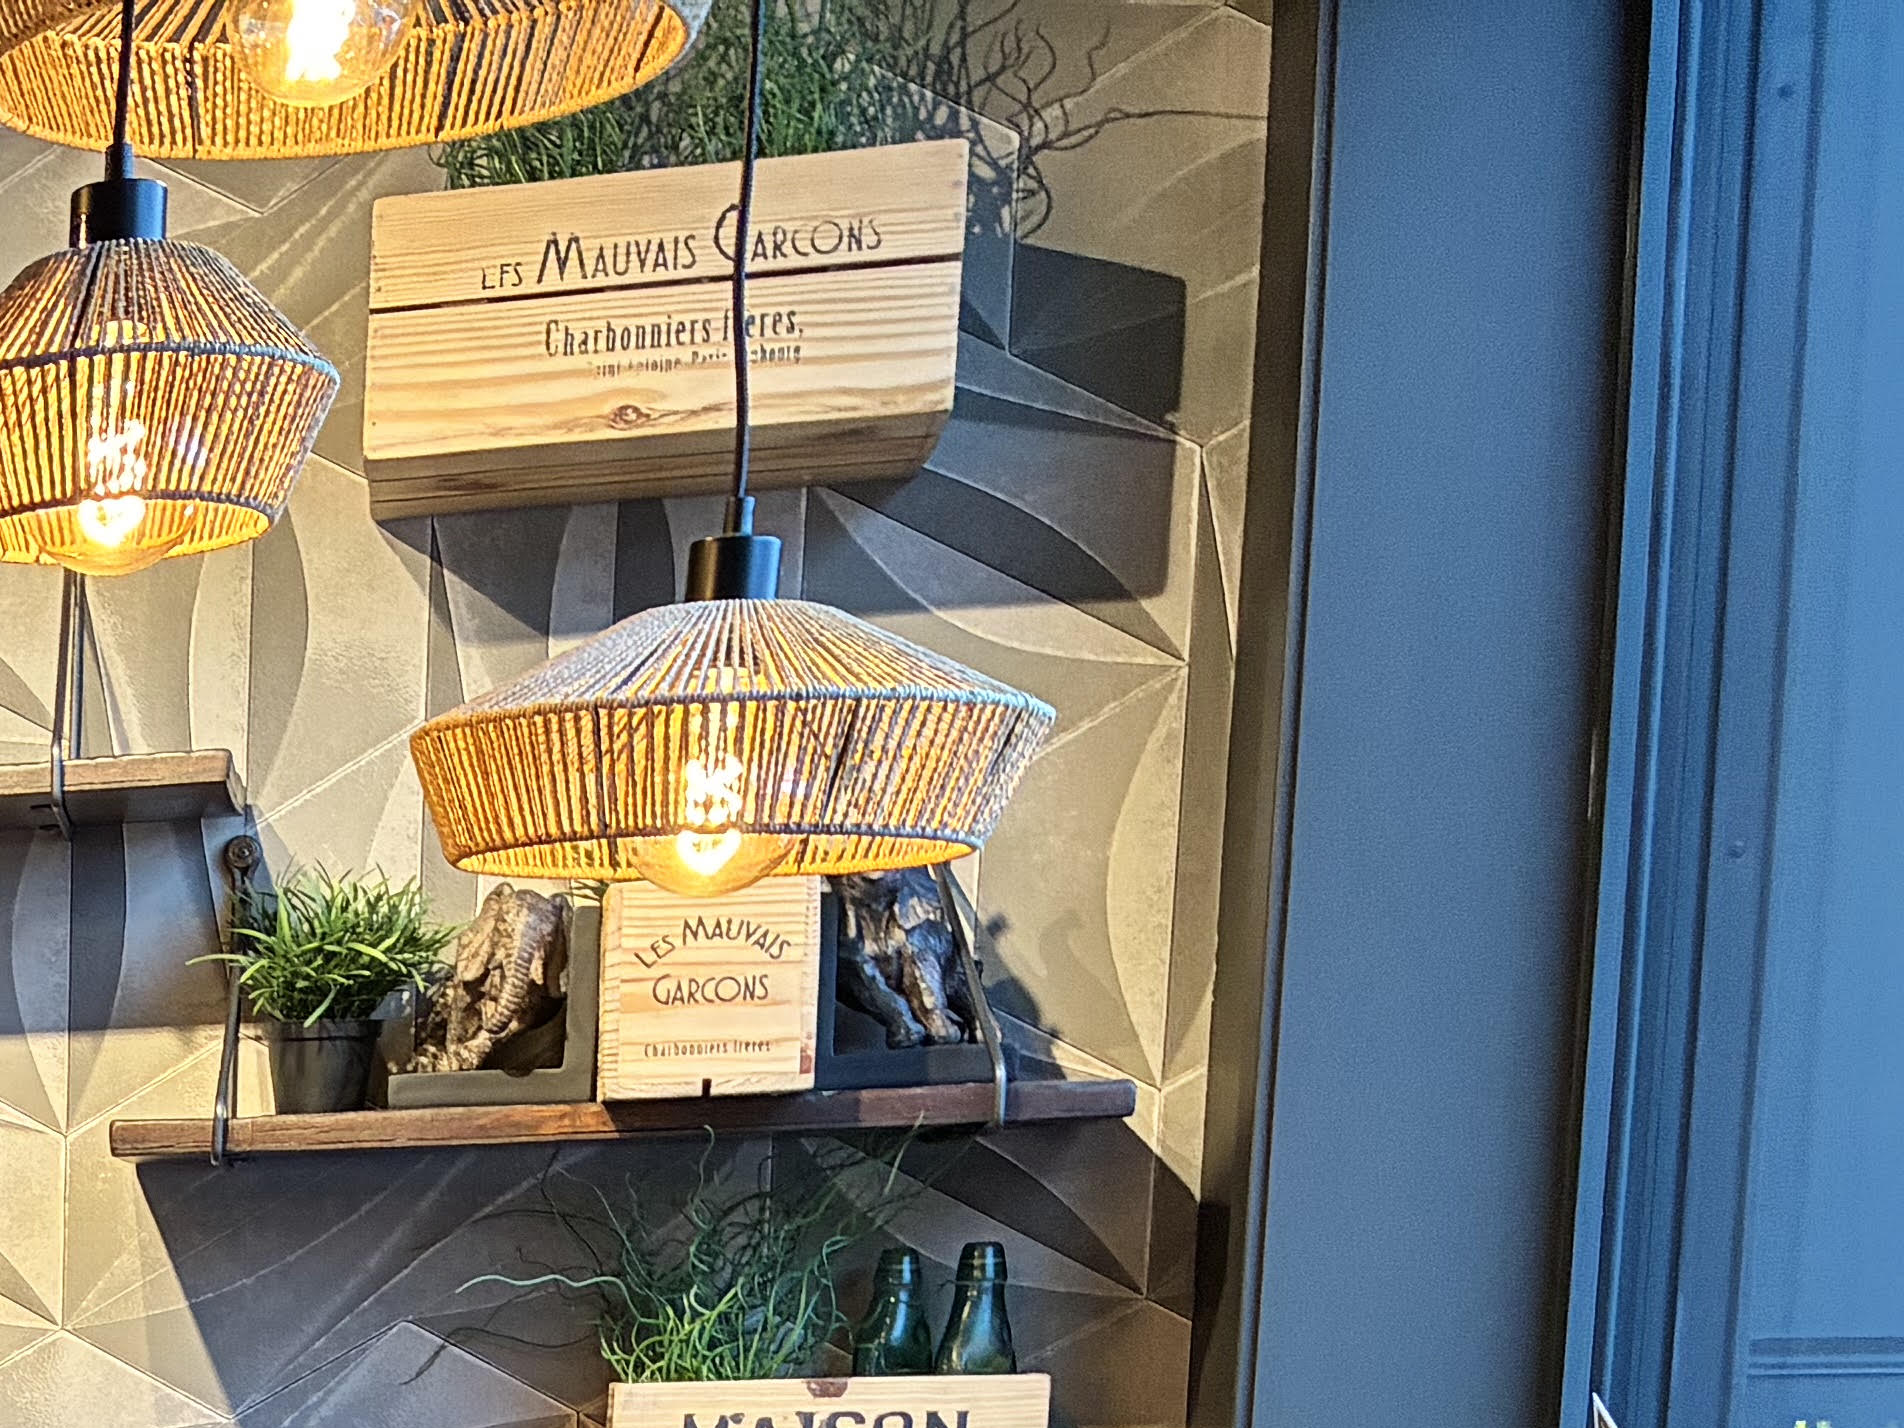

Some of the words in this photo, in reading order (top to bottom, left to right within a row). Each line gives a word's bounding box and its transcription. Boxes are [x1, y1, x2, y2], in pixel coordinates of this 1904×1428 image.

[536, 232, 697, 285] MAUVAIS
[545, 314, 712, 357] Charbonniers
[633, 934, 676, 969] LES
[682, 915, 792, 960] MAUVAIS
[652, 973, 770, 1006] GARCONS
